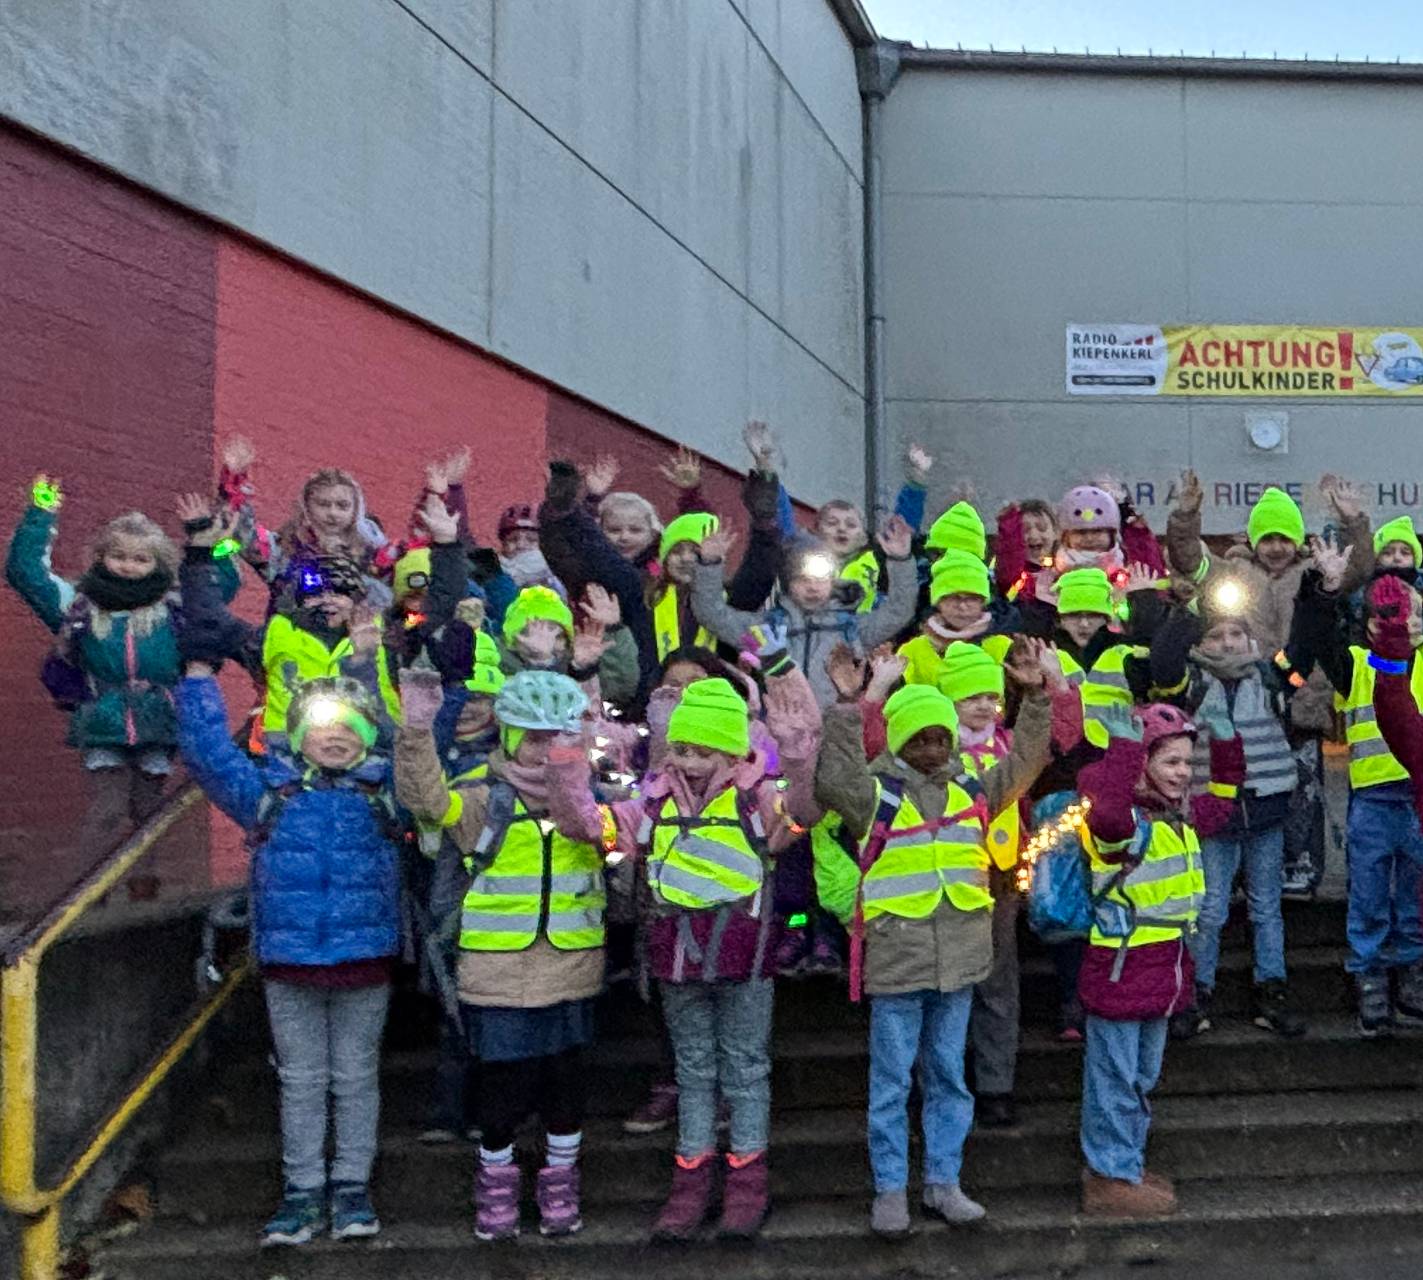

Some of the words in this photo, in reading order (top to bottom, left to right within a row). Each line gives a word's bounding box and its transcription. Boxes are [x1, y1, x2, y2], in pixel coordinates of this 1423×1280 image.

[1072, 333, 1117, 345] RADIO
[1072, 347, 1153, 360] KIEPENKERL
[1178, 371, 1335, 390] SCHULKINDER
